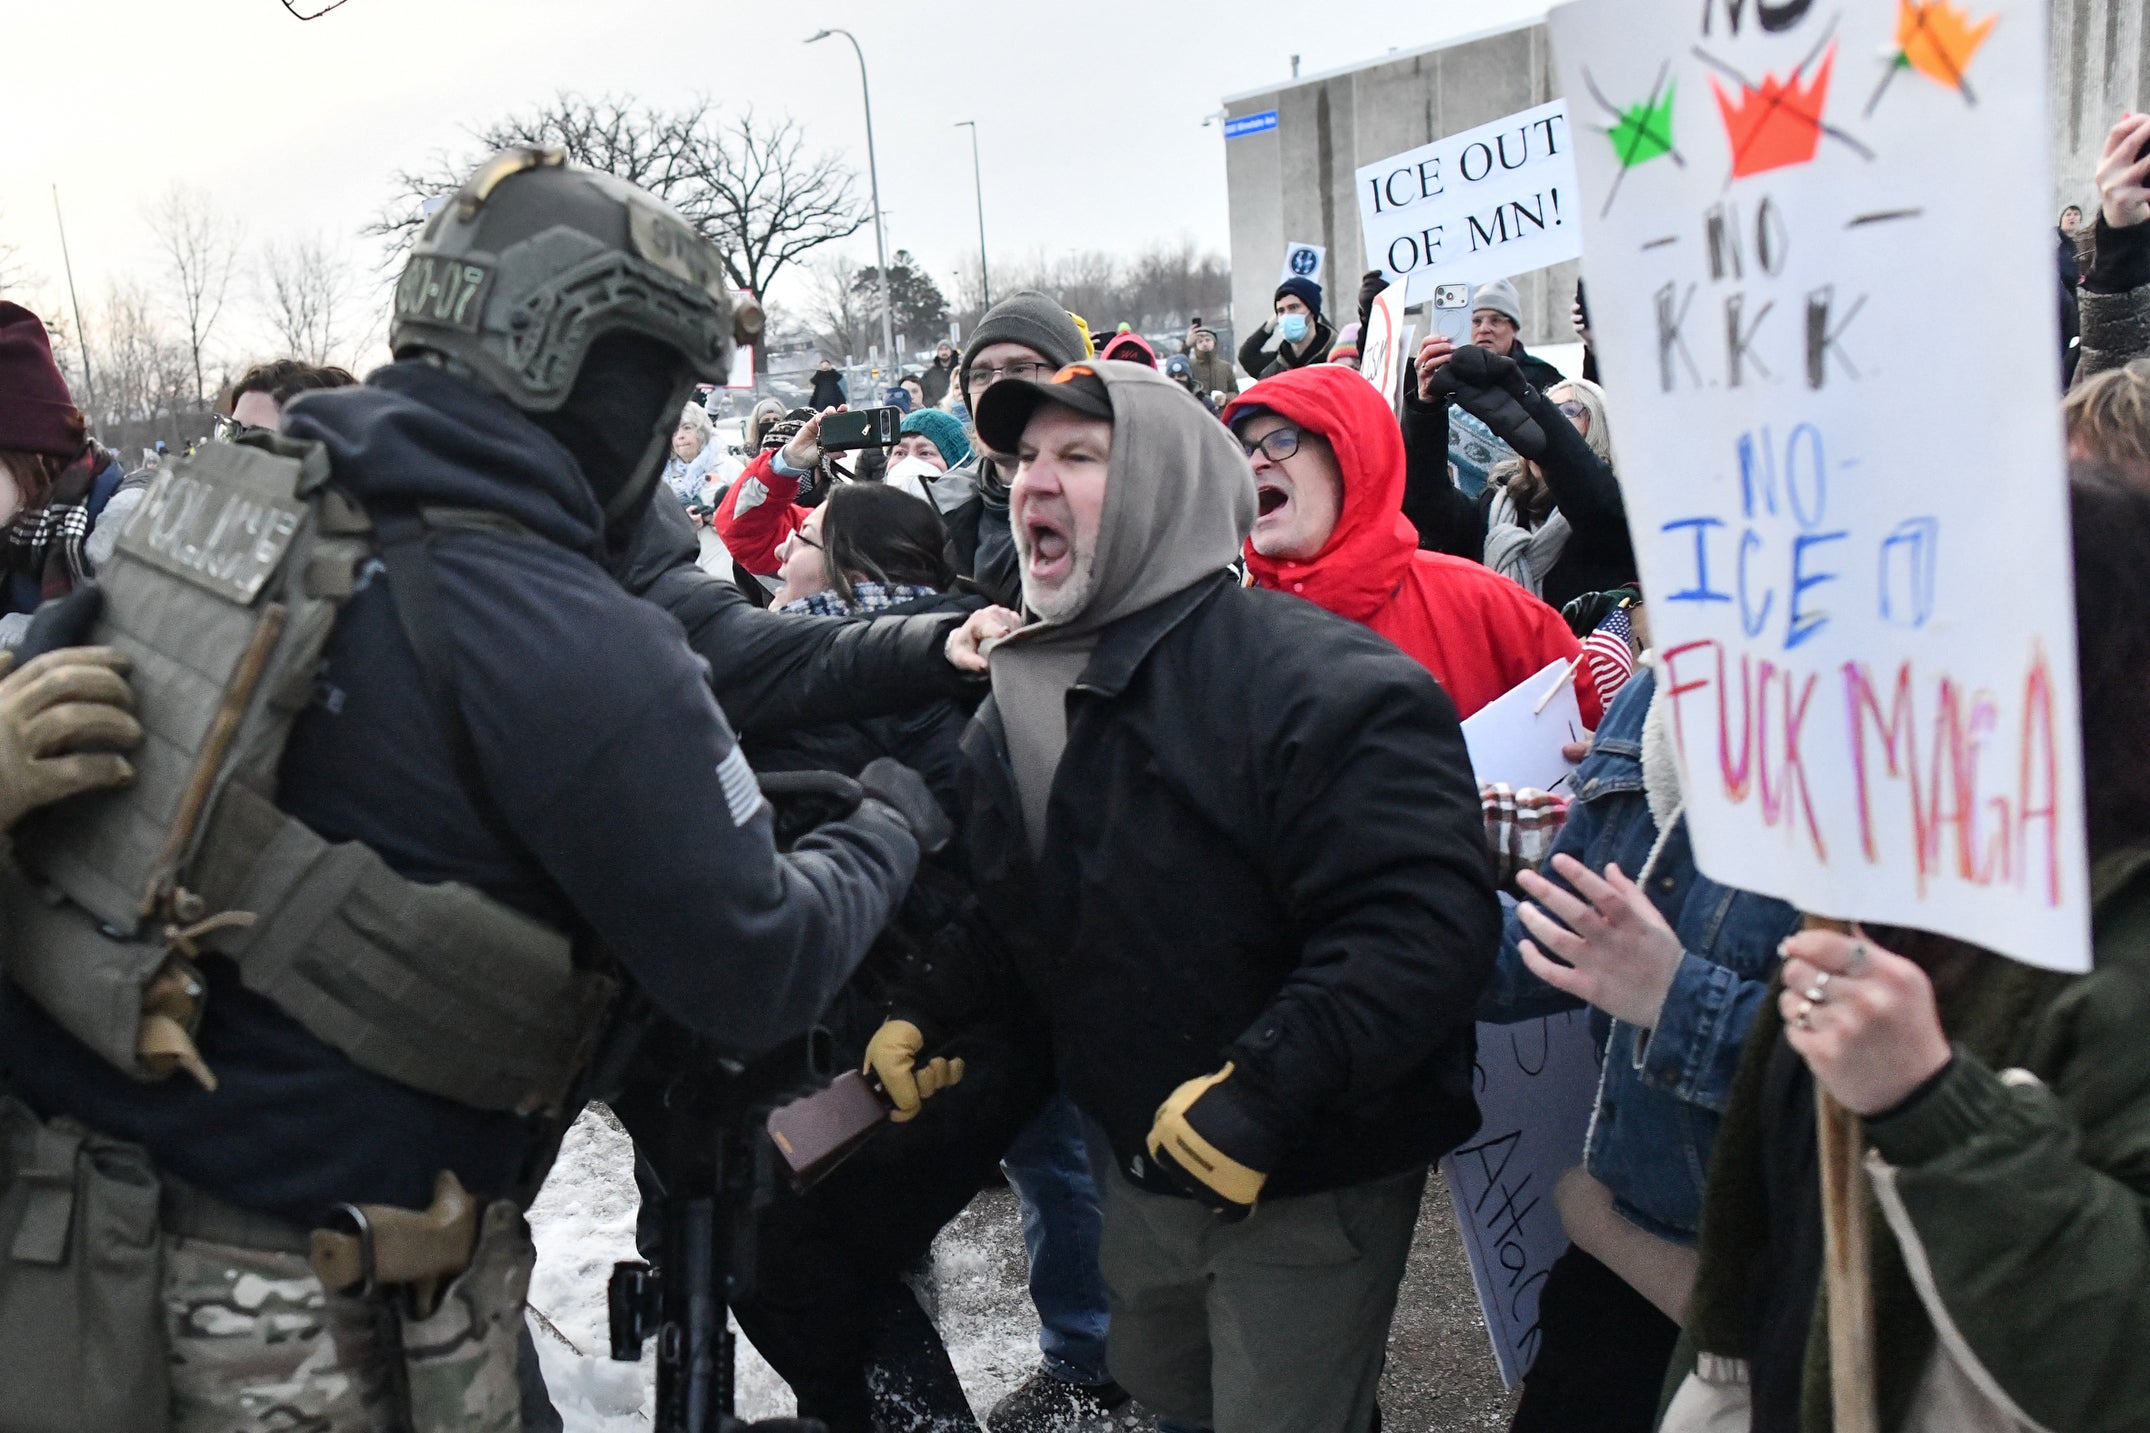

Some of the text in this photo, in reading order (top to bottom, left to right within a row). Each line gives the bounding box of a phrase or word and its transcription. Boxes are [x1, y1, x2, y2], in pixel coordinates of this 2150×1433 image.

[1370, 114, 1564, 214] ICE OUT
[1388, 187, 1563, 274] OF MN!
[1660, 516, 1850, 650] ICE
[1662, 638, 2062, 908] FUCK MAGA
